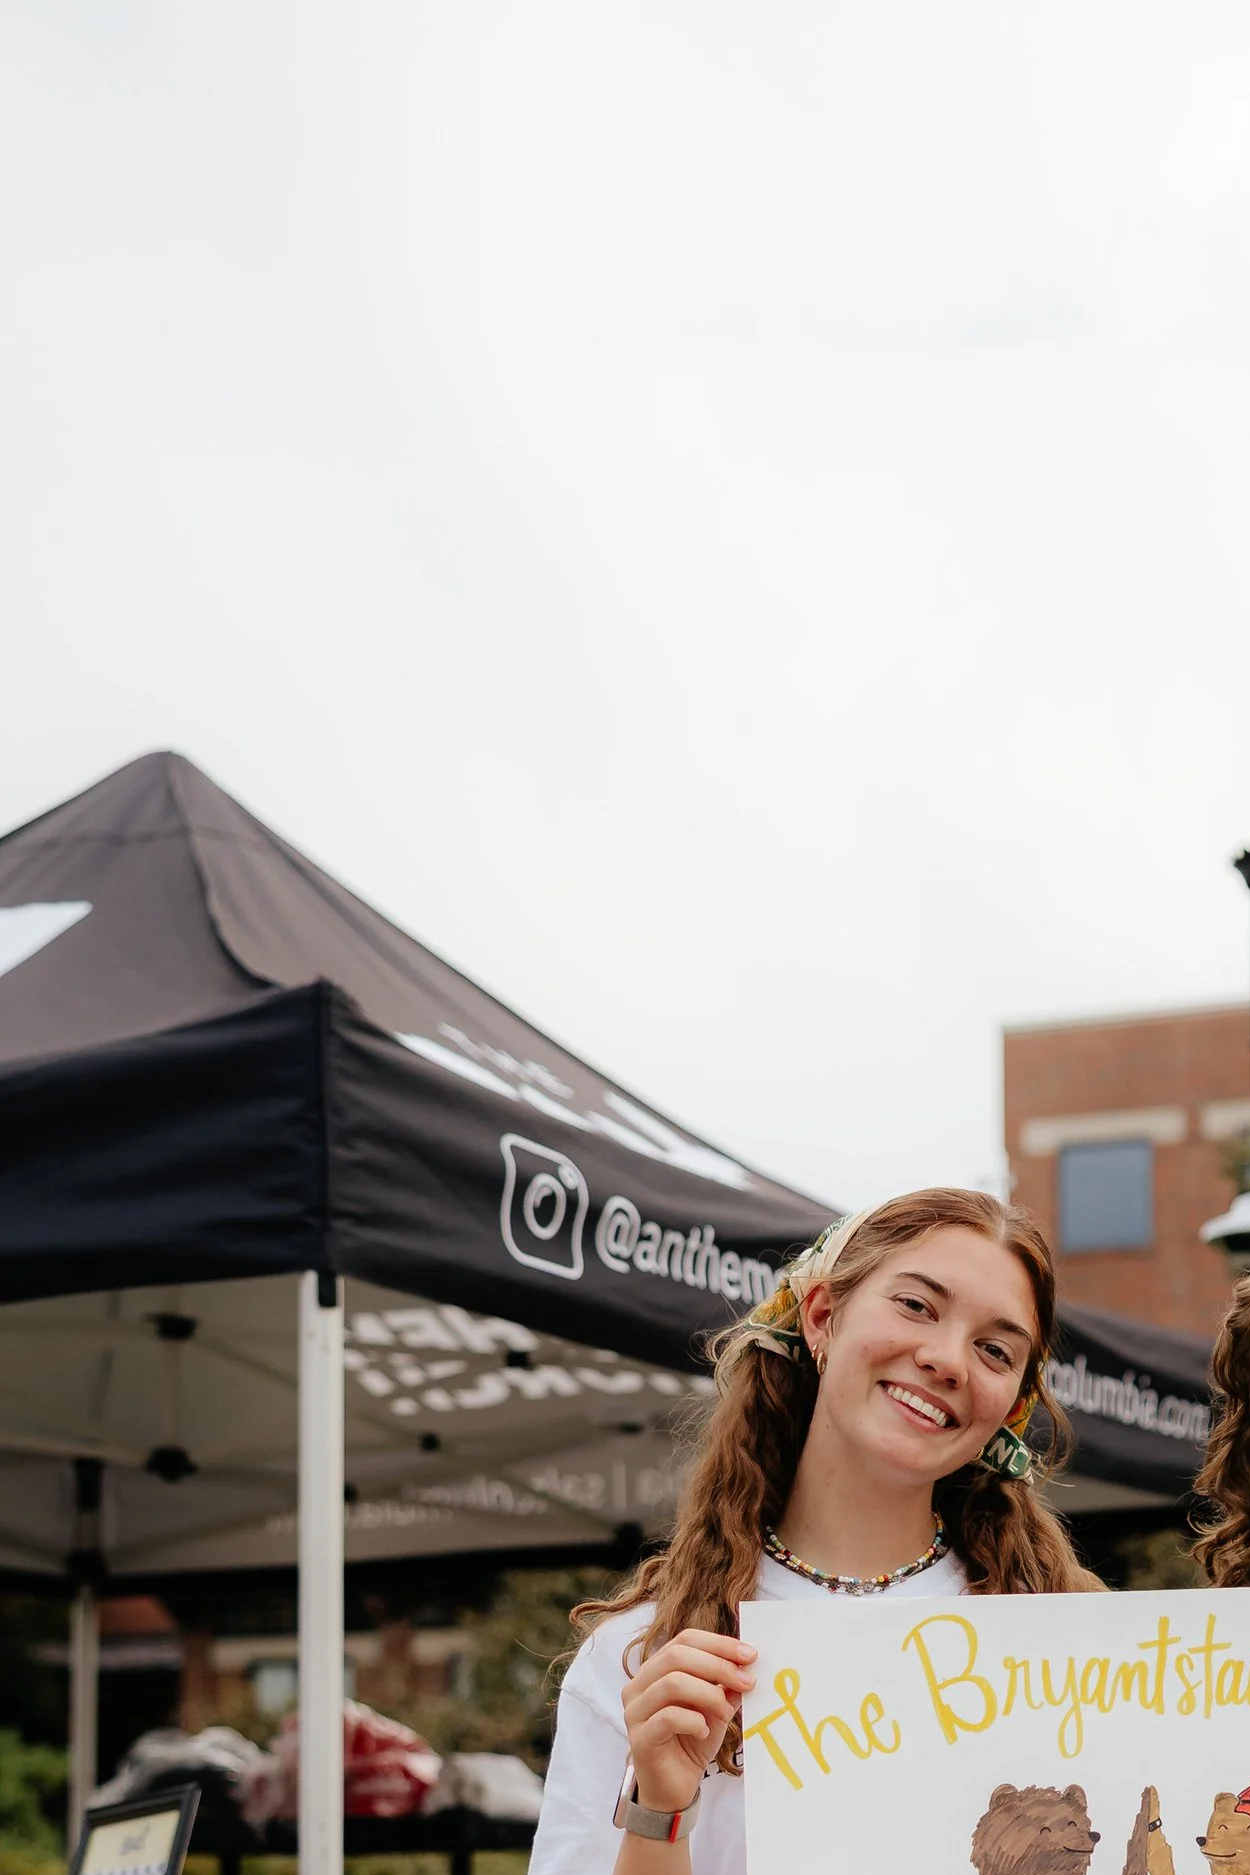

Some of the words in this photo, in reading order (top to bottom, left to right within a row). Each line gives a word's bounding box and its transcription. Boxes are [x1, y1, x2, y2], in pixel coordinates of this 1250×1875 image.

[595, 1195, 787, 1305] @anthem
[1041, 1354, 1211, 1441] columbia.com
[743, 1667, 902, 1791] The
